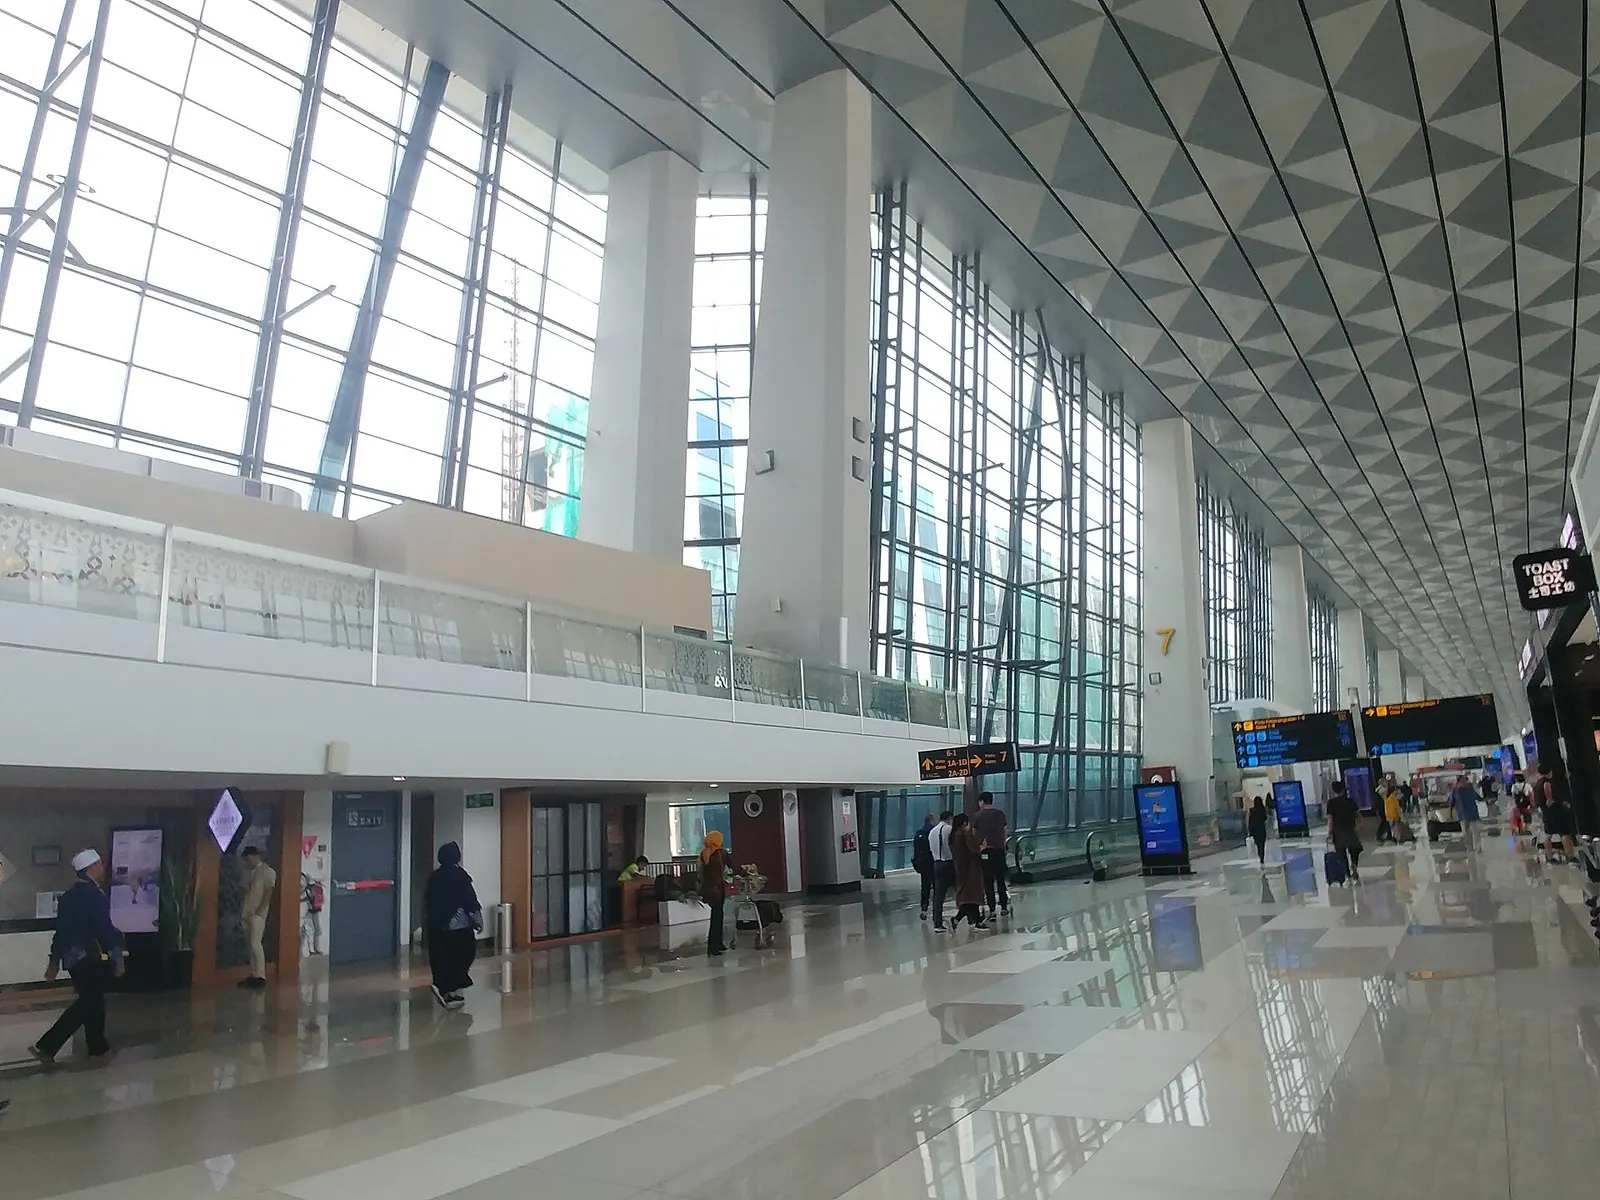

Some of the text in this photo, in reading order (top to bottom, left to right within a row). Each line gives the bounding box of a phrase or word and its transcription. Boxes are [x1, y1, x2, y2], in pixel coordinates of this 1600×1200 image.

[1522, 558, 1569, 576] TOAST
[1533, 572, 1565, 587] BOX
[1155, 627, 1174, 656] 7
[946, 749, 957, 757] 6-1
[999, 750, 1007, 762] 7
[947, 759, 968, 767] 1A-1D
[948, 769, 969, 777] 2A-2D
[360, 817, 382, 825] EXIT
